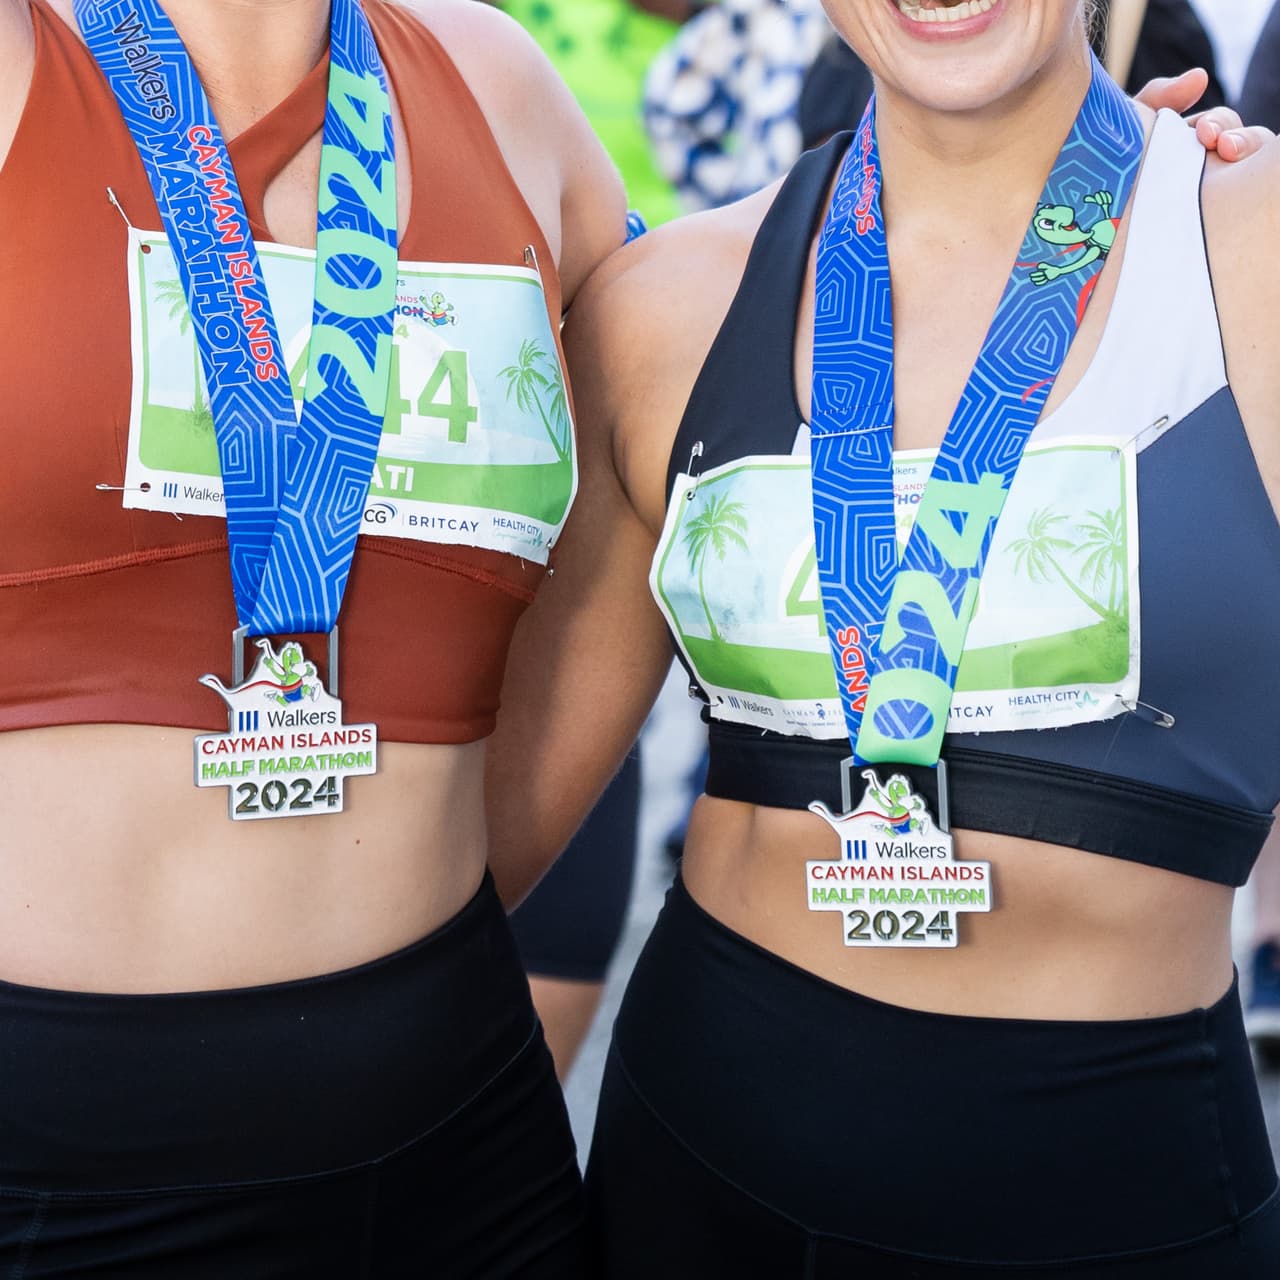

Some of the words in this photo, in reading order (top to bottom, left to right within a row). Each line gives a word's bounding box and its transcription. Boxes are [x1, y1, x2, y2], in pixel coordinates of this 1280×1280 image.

[113, 10, 176, 120] Walkers
[304, 61, 398, 418] 2024
[145, 131, 251, 387] MARATHON
[188, 126, 243, 244] CAYMAN
[226, 251, 278, 380] ISLANDS
[408, 515, 480, 533] BRITCAY
[493, 517, 526, 531] HEALTH
[740, 700, 774, 716] Walkers
[1008, 694, 1052, 706] HEALTH
[1055, 690, 1081, 701] CITY
[267, 710, 337, 728] Walkers
[202, 736, 286, 754] CAYMAN
[290, 728, 373, 747] ISLANDS
[201, 759, 257, 779] HALF
[258, 750, 373, 775] MARATHON
[235, 775, 340, 815] 2024
[875, 841, 947, 860] Walkers
[811, 865, 894, 880] CAYMAN
[900, 866, 985, 880] ISLANDS
[812, 886, 864, 904] HALF
[868, 887, 986, 905] MARATHON
[846, 909, 953, 941] 2024
